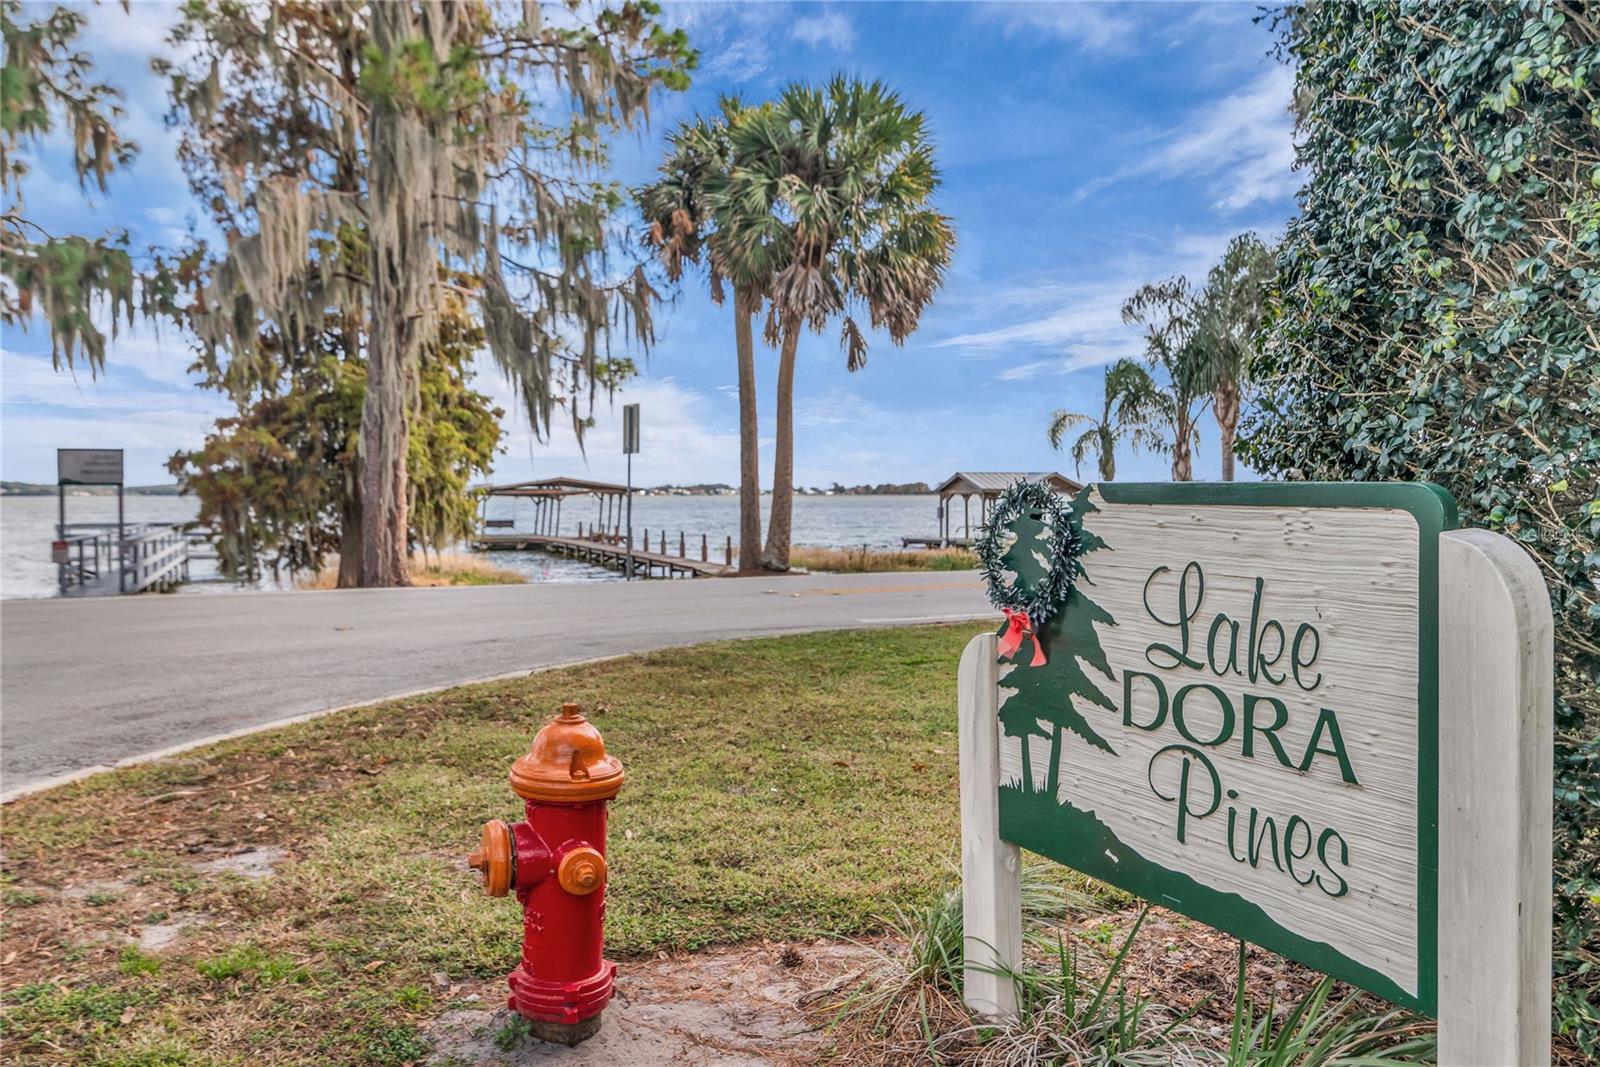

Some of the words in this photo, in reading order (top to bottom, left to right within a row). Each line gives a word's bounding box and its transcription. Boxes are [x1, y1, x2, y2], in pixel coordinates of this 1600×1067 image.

[1143, 561, 1321, 691] Lake
[1122, 669, 1359, 785] DORA
[1148, 744, 1349, 898] Pines
